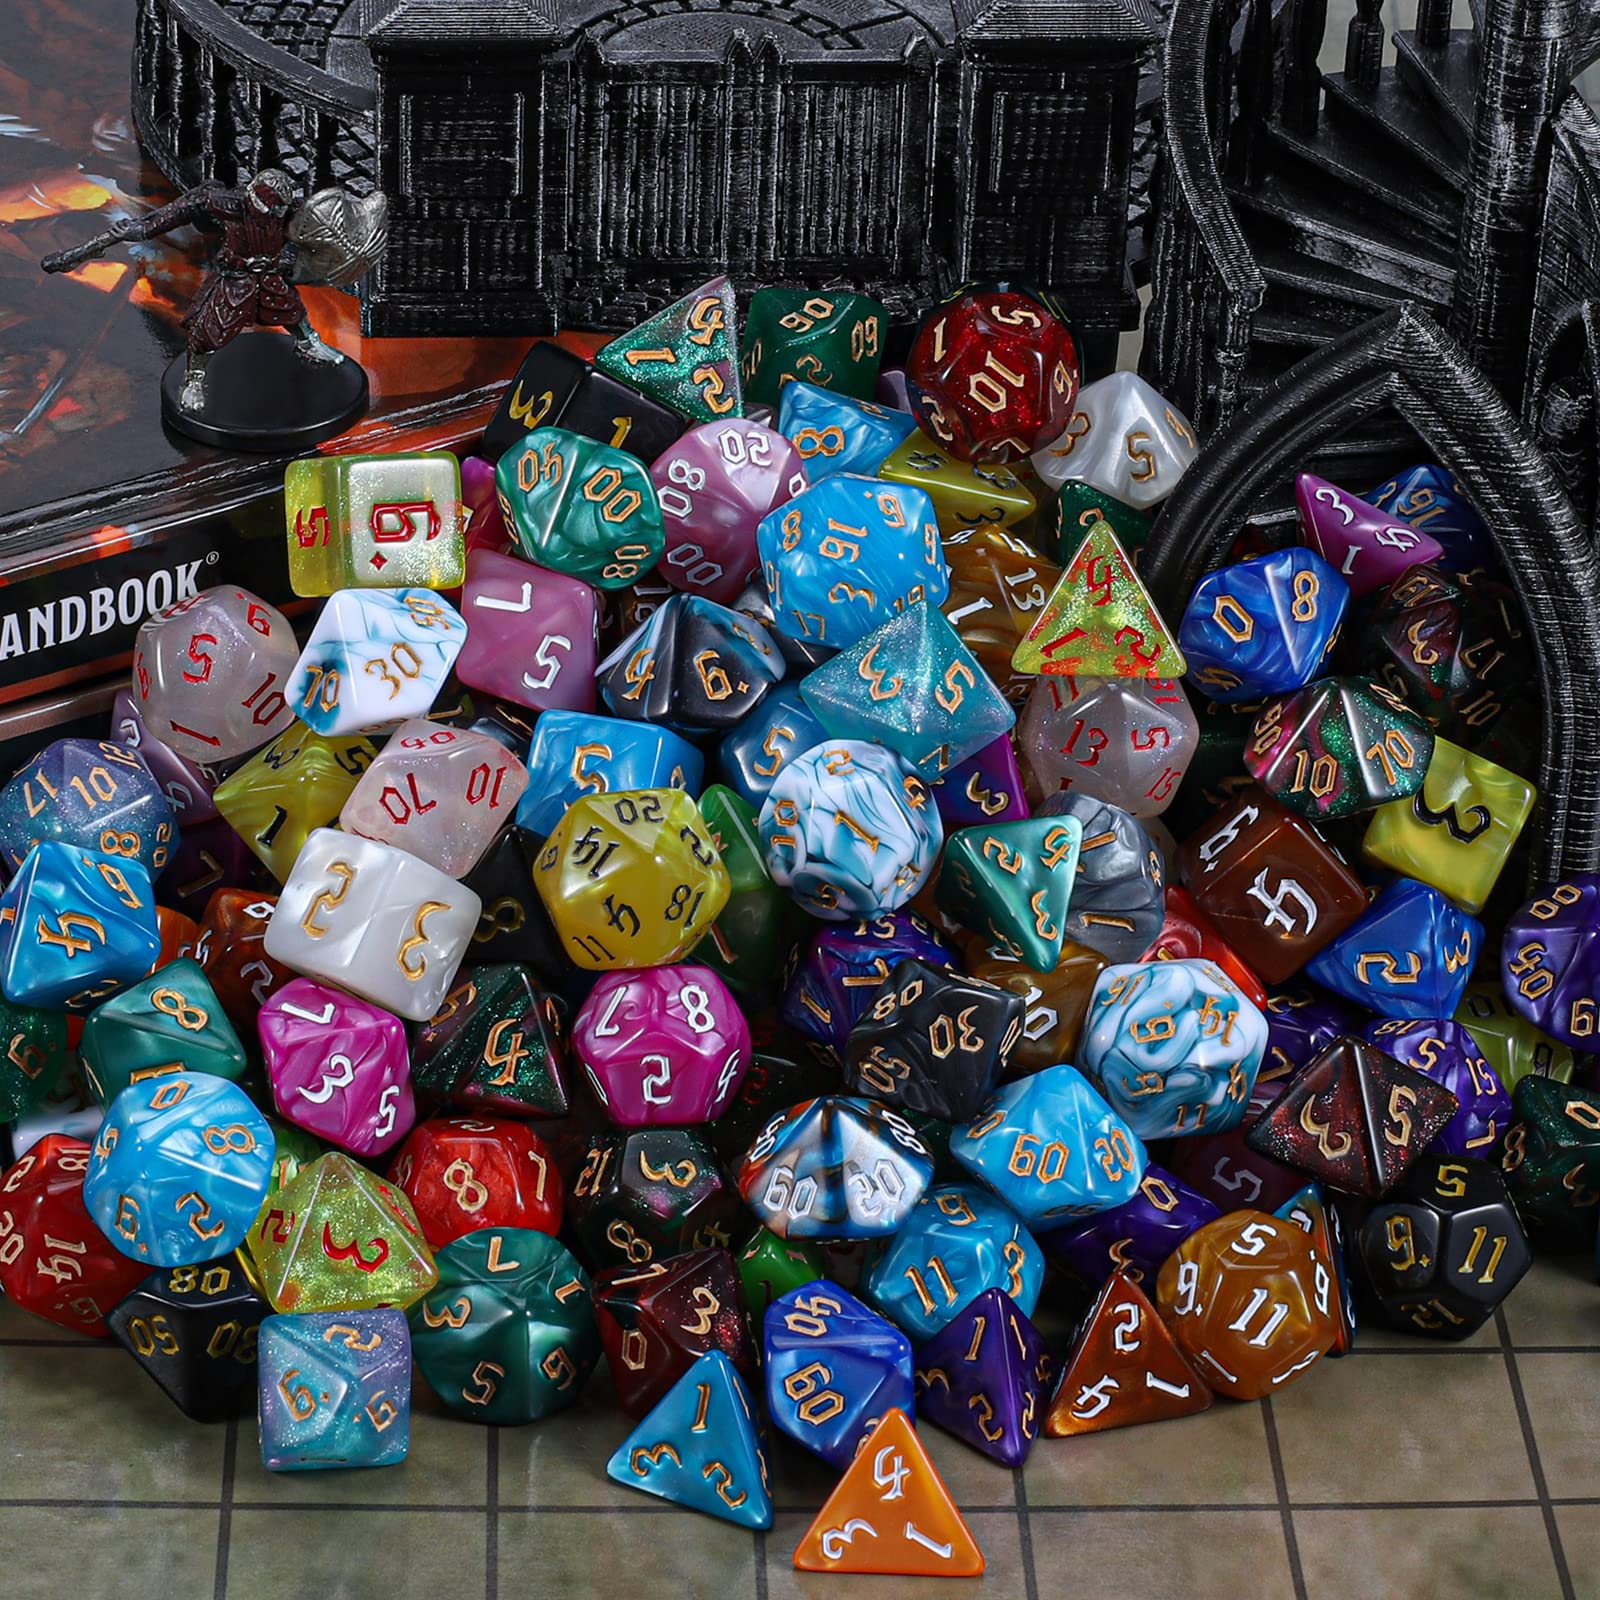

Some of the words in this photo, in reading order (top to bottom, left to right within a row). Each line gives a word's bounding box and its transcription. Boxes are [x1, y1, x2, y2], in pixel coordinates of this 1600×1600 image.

[688, 297, 724, 346] 4
[934, 317, 947, 363] 1
[625, 346, 676, 366] 1
[508, 379, 553, 430] 3
[692, 366, 734, 414] 2
[970, 350, 1025, 413] 10
[922, 395, 953, 441] 2
[1050, 411, 1091, 457] 3
[718, 427, 773, 467] 20
[792, 426, 845, 459] 8
[1126, 431, 1156, 483] 5
[517, 442, 564, 493] 40
[658, 458, 706, 518] 80
[583, 466, 642, 523] 00
[954, 506, 1006, 526] 3
[1316, 487, 1355, 526] 3
[295, 506, 331, 549] 5
[781, 509, 803, 553] 8
[818, 518, 868, 563] 16
[1376, 526, 1422, 553] 4
[603, 544, 650, 579] 80
[666, 543, 723, 586] 00
[1086, 555, 1118, 608] 4
[1341, 544, 1363, 575] 1
[473, 581, 532, 613] 7
[828, 581, 876, 611] 3
[947, 597, 994, 625] 1
[1004, 567, 1046, 613] 13
[1292, 570, 1320, 623] 8
[792, 610, 826, 640] 17
[1212, 594, 1255, 644] 0
[1407, 618, 1439, 665] 3
[182, 633, 219, 684] 5
[521, 634, 572, 690] 5
[1039, 627, 1088, 658] 1
[1113, 625, 1161, 665] 2
[303, 665, 341, 713] 70
[364, 641, 422, 700] 30
[622, 648, 656, 700] 4
[858, 643, 902, 701] 3
[935, 659, 976, 715] 5
[241, 672, 287, 726] 10
[170, 719, 221, 747] 1
[753, 727, 796, 777] 5
[1060, 718, 1109, 767] 13
[1131, 727, 1170, 752] 5
[570, 743, 613, 794] 5
[1290, 749, 1338, 798] 10
[1365, 729, 1415, 785] 70
[70, 767, 118, 810] 10
[379, 772, 437, 825] 70
[465, 762, 508, 811] 10
[966, 772, 1009, 816] 3
[1143, 766, 1182, 803] 15
[255, 804, 288, 849] 1
[614, 796, 664, 825] 20
[834, 809, 879, 854] 1
[1412, 787, 1491, 845] 3
[100, 830, 141, 857] 8
[680, 825, 715, 867] 2
[984, 836, 1024, 875] 2
[1040, 827, 1071, 870] 4
[302, 861, 356, 938] 2
[603, 894, 641, 937] 4
[664, 884, 705, 928] 18
[1032, 889, 1058, 941] 3
[1080, 911, 1136, 933] 1
[1246, 866, 1319, 935] 4
[1529, 884, 1584, 920] 00
[37, 910, 106, 958] 4
[398, 900, 452, 982] 3
[572, 935, 616, 963] 11
[1443, 930, 1472, 974] 3
[1356, 952, 1423, 985] 2
[152, 988, 208, 1032] 8
[280, 1001, 336, 1025] 7
[595, 985, 628, 1037] 7
[679, 982, 715, 1033] 8
[873, 979, 923, 1021] 80
[484, 1018, 529, 1086] 4
[928, 1005, 984, 1060] 30
[1409, 1036, 1446, 1072] 5
[150, 1080, 192, 1110] 0
[297, 1053, 355, 1104] 3
[641, 1055, 672, 1105] 2
[714, 1048, 741, 1103] 4
[1465, 1056, 1497, 1097] 15
[373, 1085, 401, 1138] 5
[1174, 1103, 1209, 1131] 11
[1300, 1092, 1352, 1161] 3
[1384, 1083, 1417, 1148] 5
[1465, 1119, 1496, 1149] 7
[202, 1124, 256, 1155] 8
[1008, 1134, 1069, 1184] 60
[1094, 1127, 1135, 1183] 20
[1501, 1122, 1528, 1172] 8
[443, 1157, 490, 1213] 8
[641, 1150, 697, 1188] 3
[1435, 1163, 1469, 1197] 5
[763, 1166, 818, 1219] 60
[1140, 1175, 1179, 1212] 0
[176, 1191, 225, 1241] 2
[321, 1221, 390, 1274] 3
[487, 1236, 520, 1272] 7
[606, 1218, 653, 1264] 8
[1231, 1223, 1278, 1256] 5
[1457, 1224, 1507, 1285] 11
[169, 1266, 231, 1296] 80
[555, 1277, 585, 1304] 1
[904, 1255, 959, 1316] 11
[1003, 1239, 1026, 1298] 3
[423, 1296, 472, 1329] 3
[680, 1287, 721, 1335] 3
[784, 1295, 842, 1338] 40
[1113, 1302, 1141, 1353] 2
[1228, 1287, 1290, 1347] 11
[127, 1314, 180, 1357] 50
[324, 1324, 383, 1352] 2
[621, 1327, 647, 1371] 0
[964, 1315, 987, 1361] 1
[1010, 1314, 1027, 1361] 1
[463, 1360, 505, 1406] 5
[783, 1361, 844, 1425] 60
[1072, 1374, 1121, 1420] 4
[1145, 1371, 1190, 1398] 1
[691, 1384, 711, 1433] 1
[968, 1393, 1003, 1442] 2
[631, 1443, 682, 1477] 3
[873, 1445, 912, 1501] 4
[703, 1462, 746, 1508] 2
[822, 1518, 877, 1560] 3
[904, 1521, 953, 1559] 1
